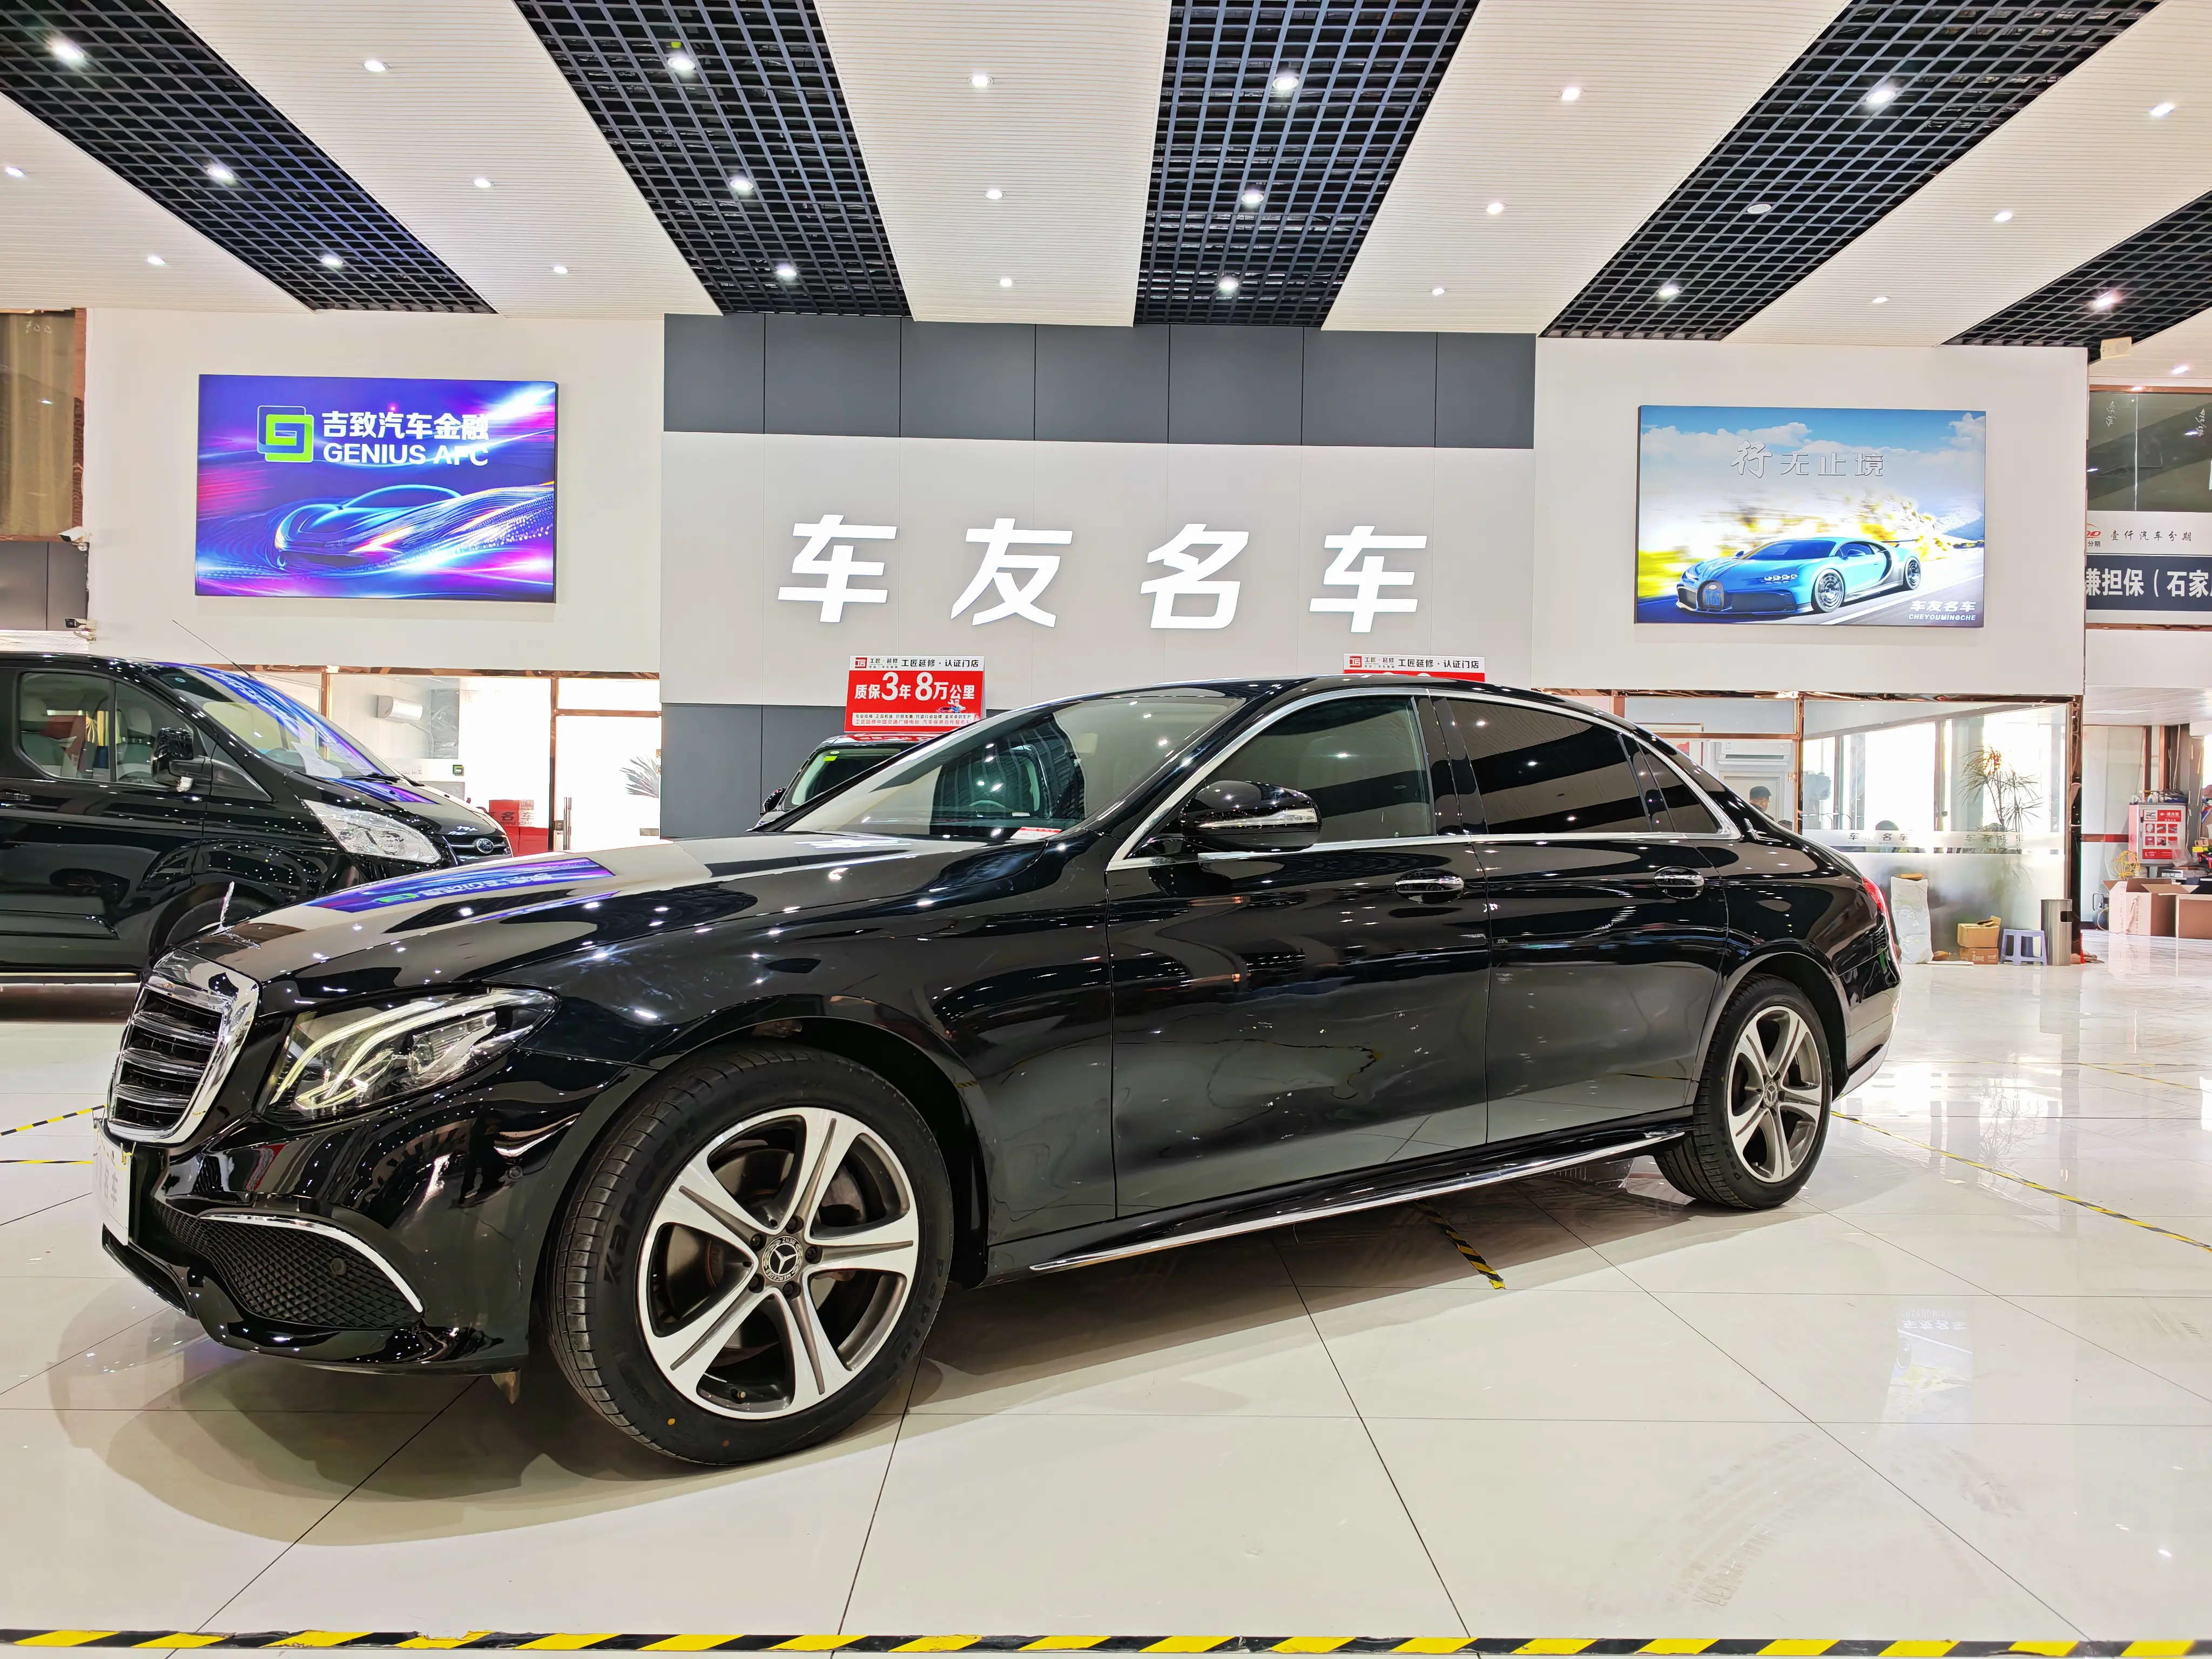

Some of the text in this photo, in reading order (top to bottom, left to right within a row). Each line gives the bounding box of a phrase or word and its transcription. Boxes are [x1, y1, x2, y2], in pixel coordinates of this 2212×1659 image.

[322, 410, 489, 441] 吉致汽车金融
[323, 443, 488, 466] GENIUS AFC
[1731, 440, 1883, 478] 行无止境
[2110, 530, 2193, 542] 壹仟汽车分期
[777, 514, 1427, 633] 车友名车
[2086, 568, 2212, 598] 兼担保（石家
[1910, 600, 1977, 612] 车友名车
[1849, 832, 1909, 841] 车名车
[765, 1269, 791, 1281] MERCEDES
